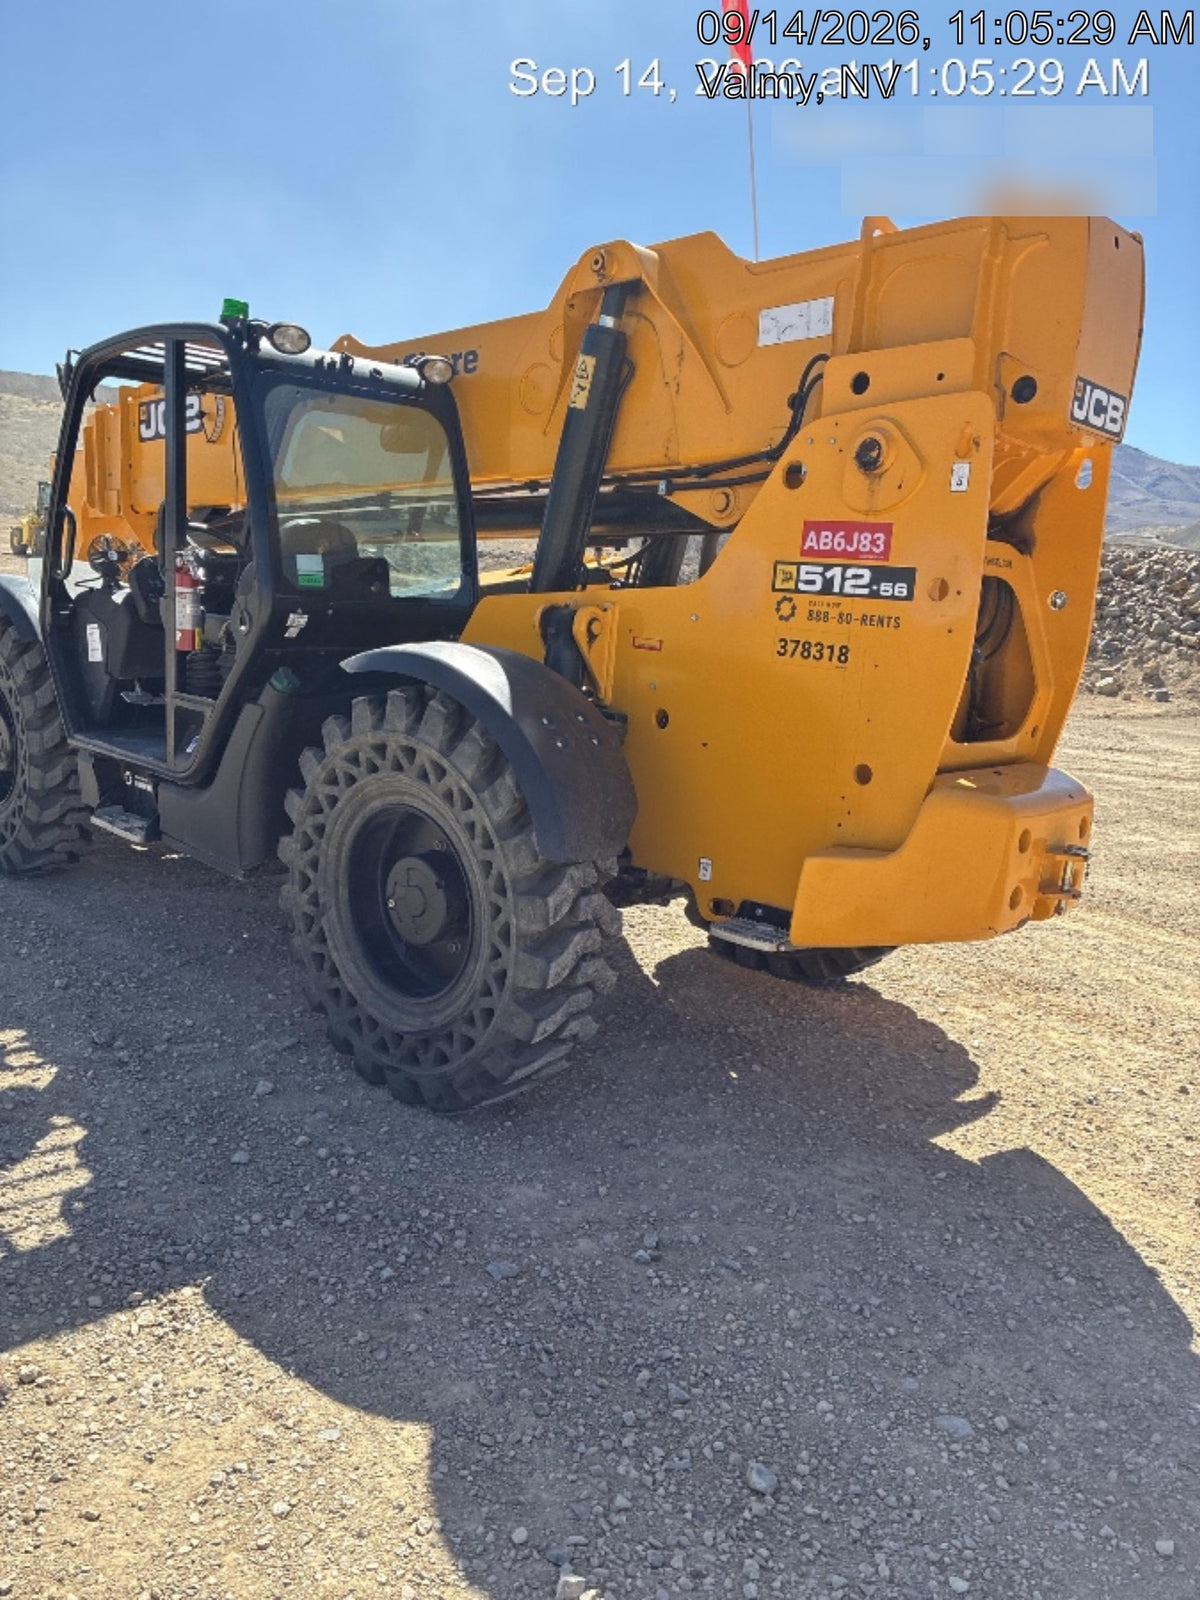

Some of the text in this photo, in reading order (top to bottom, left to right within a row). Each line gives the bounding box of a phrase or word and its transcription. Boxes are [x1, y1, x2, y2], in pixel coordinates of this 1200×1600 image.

[1073, 384, 1125, 433] JCB
[803, 530, 886, 554] AB6J83
[806, 609, 901, 629] 888-80-RENTS
[776, 637, 851, 664] 378318
